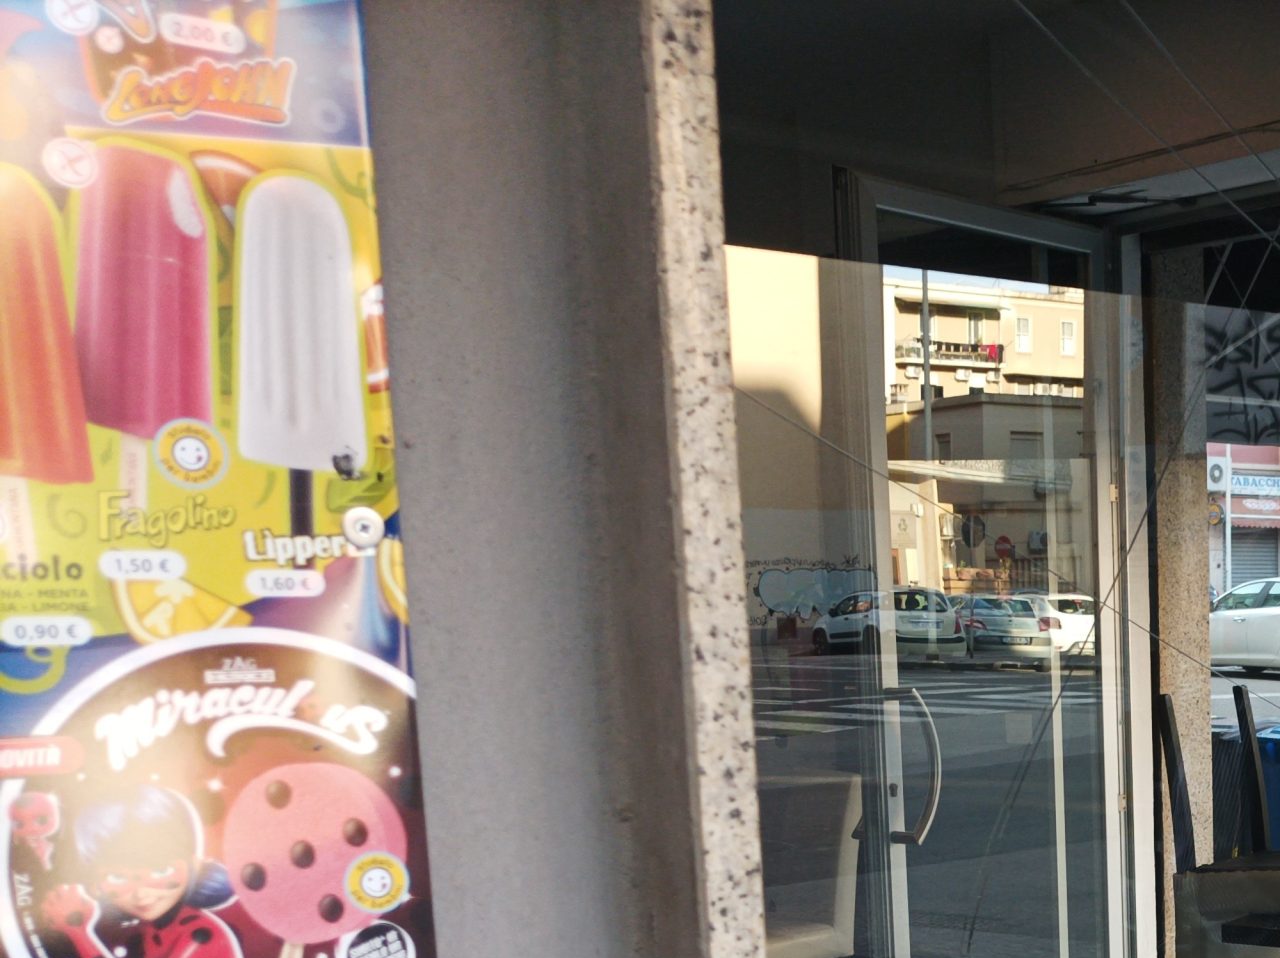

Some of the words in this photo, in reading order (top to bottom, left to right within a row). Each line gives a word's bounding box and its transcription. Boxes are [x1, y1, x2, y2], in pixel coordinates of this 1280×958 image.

[98, 489, 237, 548] Fragolino
[243, 528, 376, 567] Lipper
[114, 558, 152, 575] 1,50
[158, 557, 170, 572] €
[260, 577, 295, 593] 1,60
[301, 576, 311, 590] €
[14, 624, 60, 641] 0,90
[67, 623, 79, 639] €
